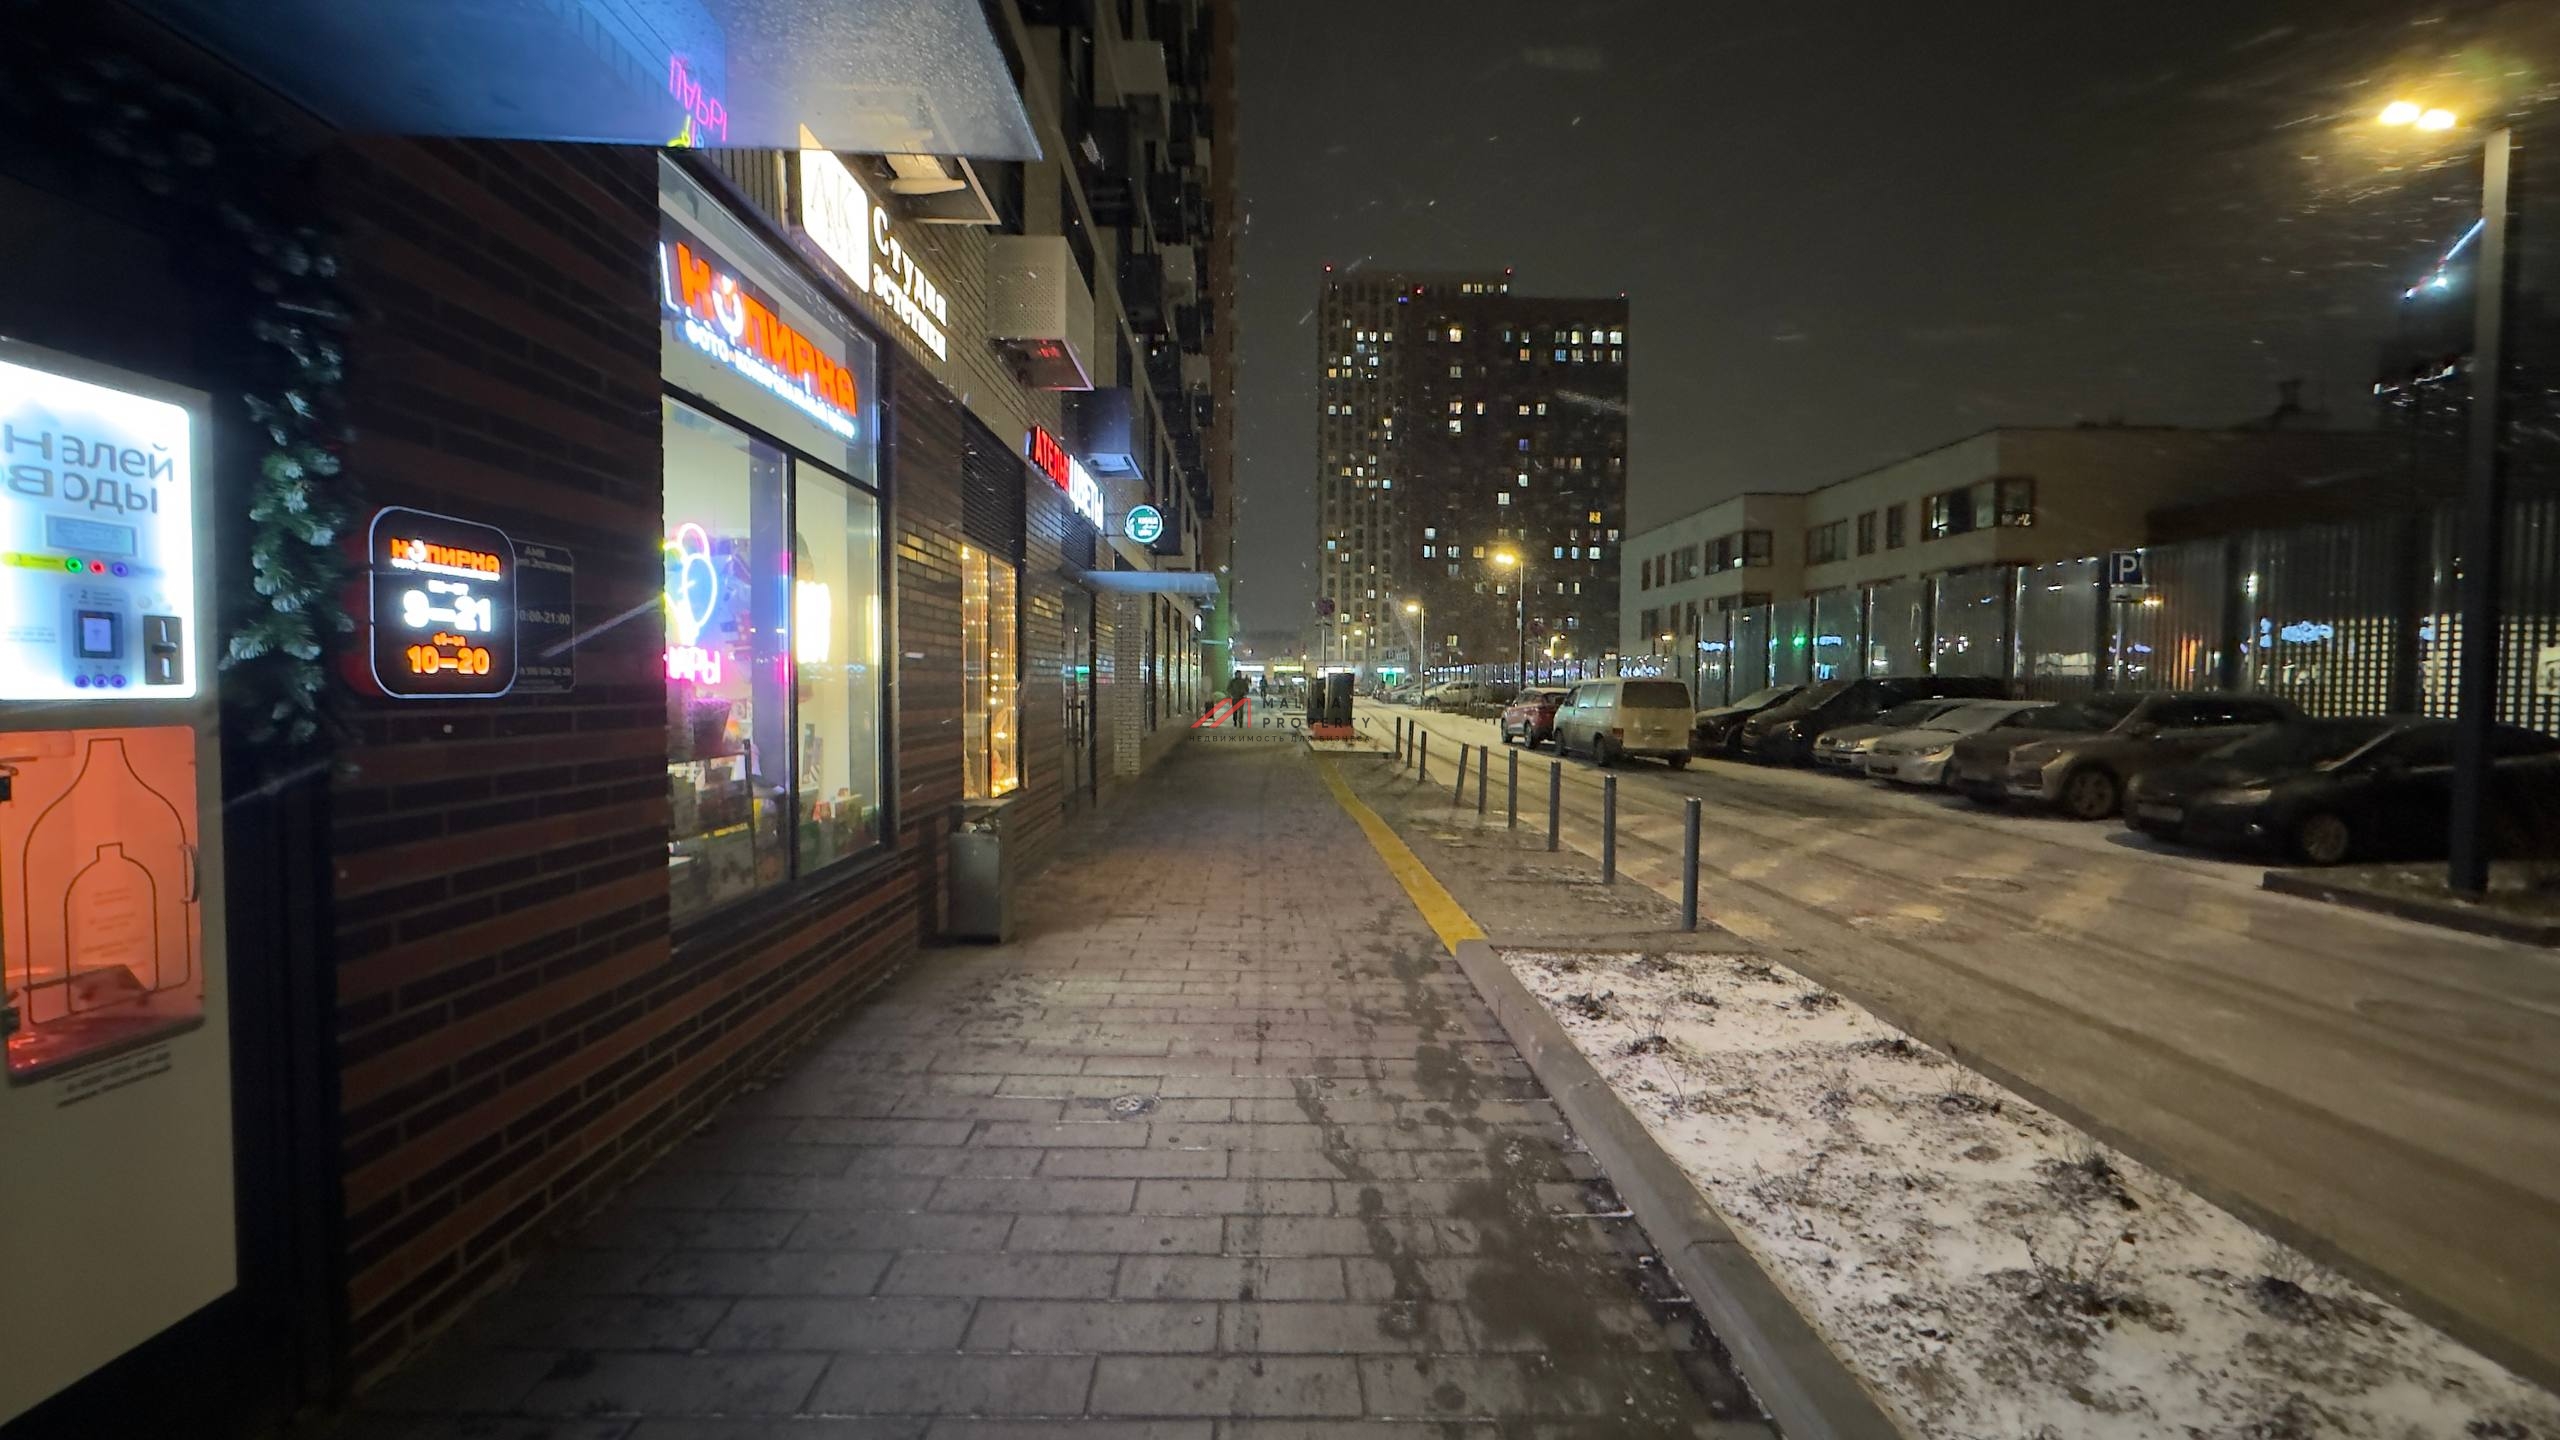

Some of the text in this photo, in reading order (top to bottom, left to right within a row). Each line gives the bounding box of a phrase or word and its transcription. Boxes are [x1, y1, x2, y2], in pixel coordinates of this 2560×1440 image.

[1034, 425, 1104, 531] АТЕЛЬЕ ЦВЕТЫ
[2119, 554, 2137, 582] P
